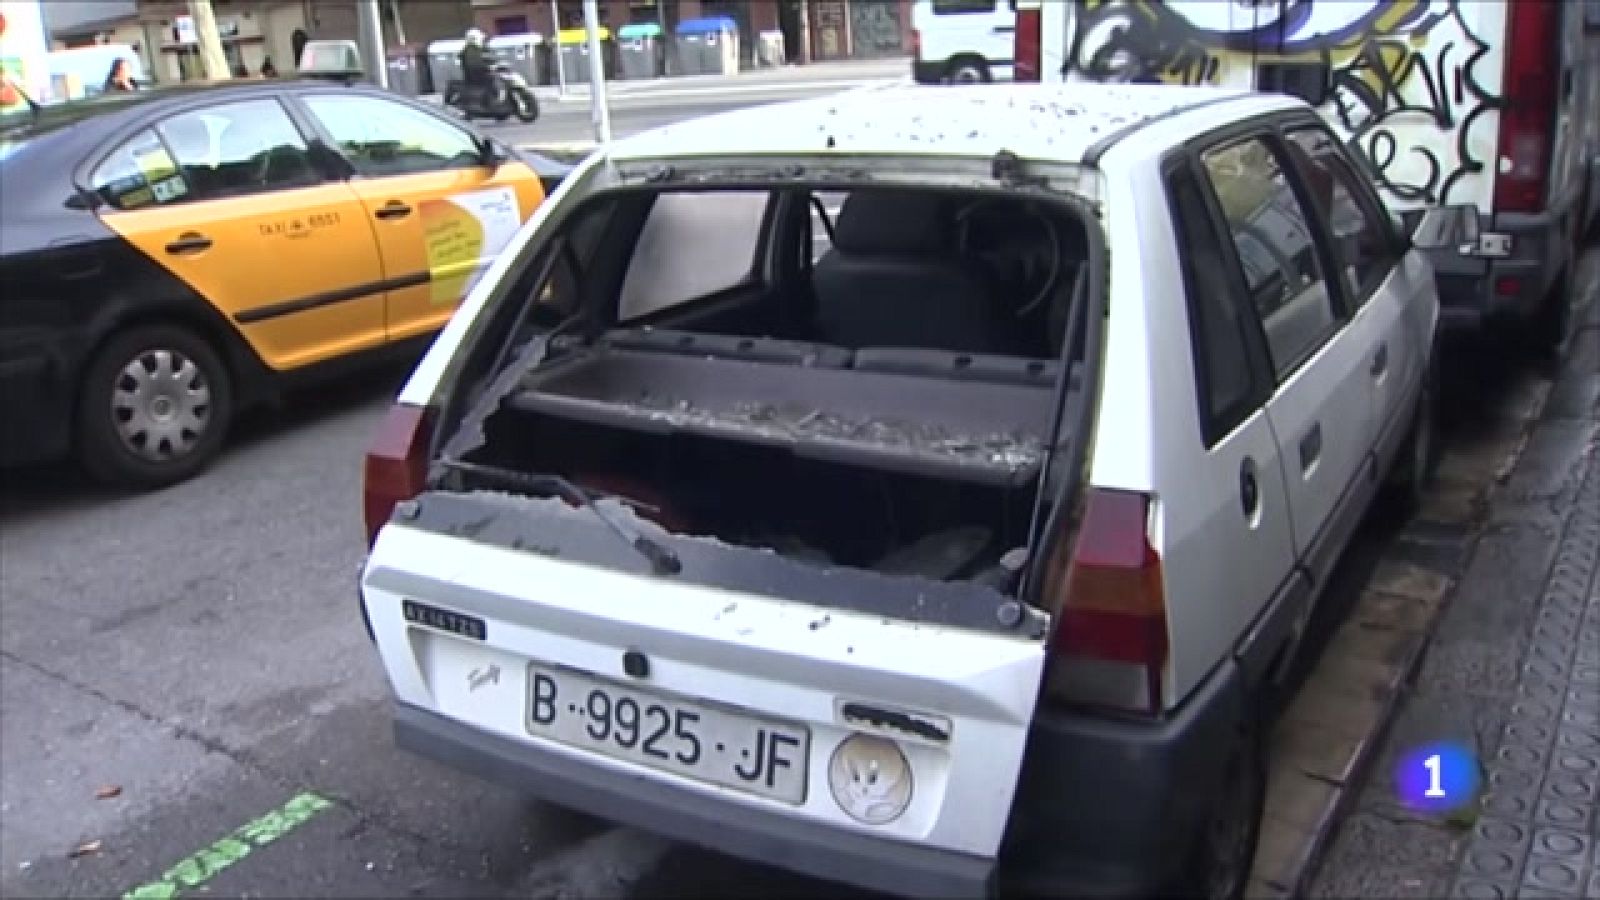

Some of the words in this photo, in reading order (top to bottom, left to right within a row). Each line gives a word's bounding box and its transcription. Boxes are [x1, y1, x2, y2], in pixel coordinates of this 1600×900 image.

[532, 672, 557, 724] B
[586, 689, 701, 765] 9925
[733, 729, 800, 788] JF
